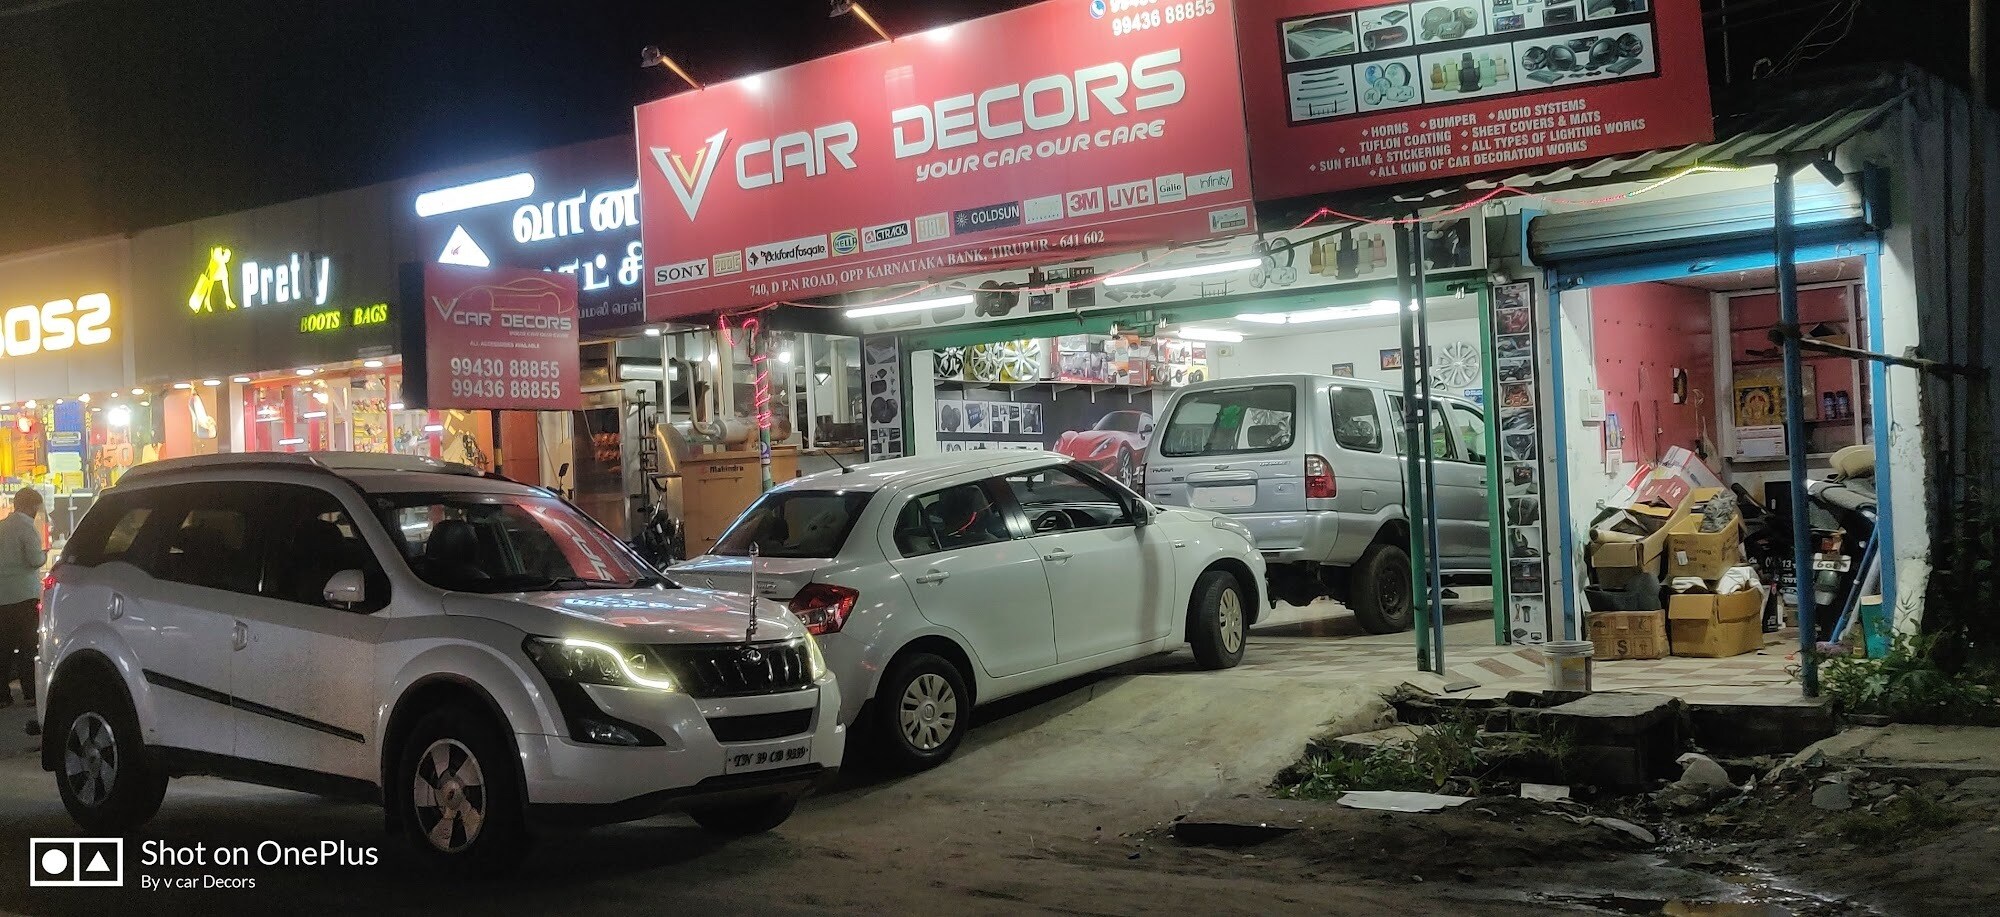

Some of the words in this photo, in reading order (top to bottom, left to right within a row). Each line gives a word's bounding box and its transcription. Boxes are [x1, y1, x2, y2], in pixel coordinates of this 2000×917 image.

[1112, 9, 1161, 36] 99436
[1165, 0, 1215, 24] 88855
[735, 121, 858, 190] CAR
[891, 48, 1186, 159] DECORS
[1359, 136, 1401, 153] TUFLON
[1404, 130, 1452, 147] COATING
[1472, 123, 1507, 138] SHEET
[1510, 117, 1554, 133] COVERS
[1558, 115, 1567, 127] &
[1570, 111, 1601, 126] MATS
[1371, 123, 1409, 138] HORNS
[1429, 113, 1477, 130] BUMPER
[1497, 106, 1531, 121] AUDIO
[1534, 99, 1587, 116] SYSTEMS
[916, 155, 980, 182] YOUR
[982, 144, 1033, 168] CAR
[1036, 133, 1090, 158] OUR
[1093, 119, 1166, 147] CARE
[1319, 159, 1342, 172] SUN
[1345, 154, 1371, 168] FILM
[1374, 153, 1383, 164] &
[1386, 144, 1452, 163] STICKERING
[1471, 139, 1491, 152] ALL
[1494, 134, 1529, 149] TYPES
[1532, 131, 1546, 144] OF
[1550, 124, 1601, 142] LIGHTING
[1604, 118, 1646, 134] WORKS
[1378, 166, 1398, 177] ALL
[1401, 160, 1426, 174] KIND
[1430, 158, 1445, 171] OF
[1448, 156, 1470, 169] CAR
[1474, 146, 1543, 165] DECORATION
[1546, 140, 1588, 156] WORKS
[971, 203, 1020, 224] GOLDSUN
[1070, 191, 1099, 211] 3M
[1110, 185, 1150, 208] JVC
[242, 252, 330, 308] Pretty
[657, 263, 706, 283] SONY
[750, 284, 770, 297] 740,
[772, 281, 779, 293] D
[802, 273, 838, 288] ROAD,
[840, 268, 863, 283] OPP
[866, 255, 945, 279] KARNATAKA
[948, 249, 987, 265] BANK,
[990, 238, 1049, 259] TIRUPUR
[1060, 236, 1079, 248] 641
[1084, 230, 1104, 245] 602
[0, 293, 112, 357] OS2
[300, 311, 341, 333] BOOTS
[353, 303, 387, 326] BAGS
[453, 312, 492, 326] CAR
[501, 313, 572, 331] DECORS
[450, 357, 504, 377] 99430
[509, 359, 560, 379] 88855
[451, 379, 505, 399] 99436
[510, 380, 561, 399] 88855
